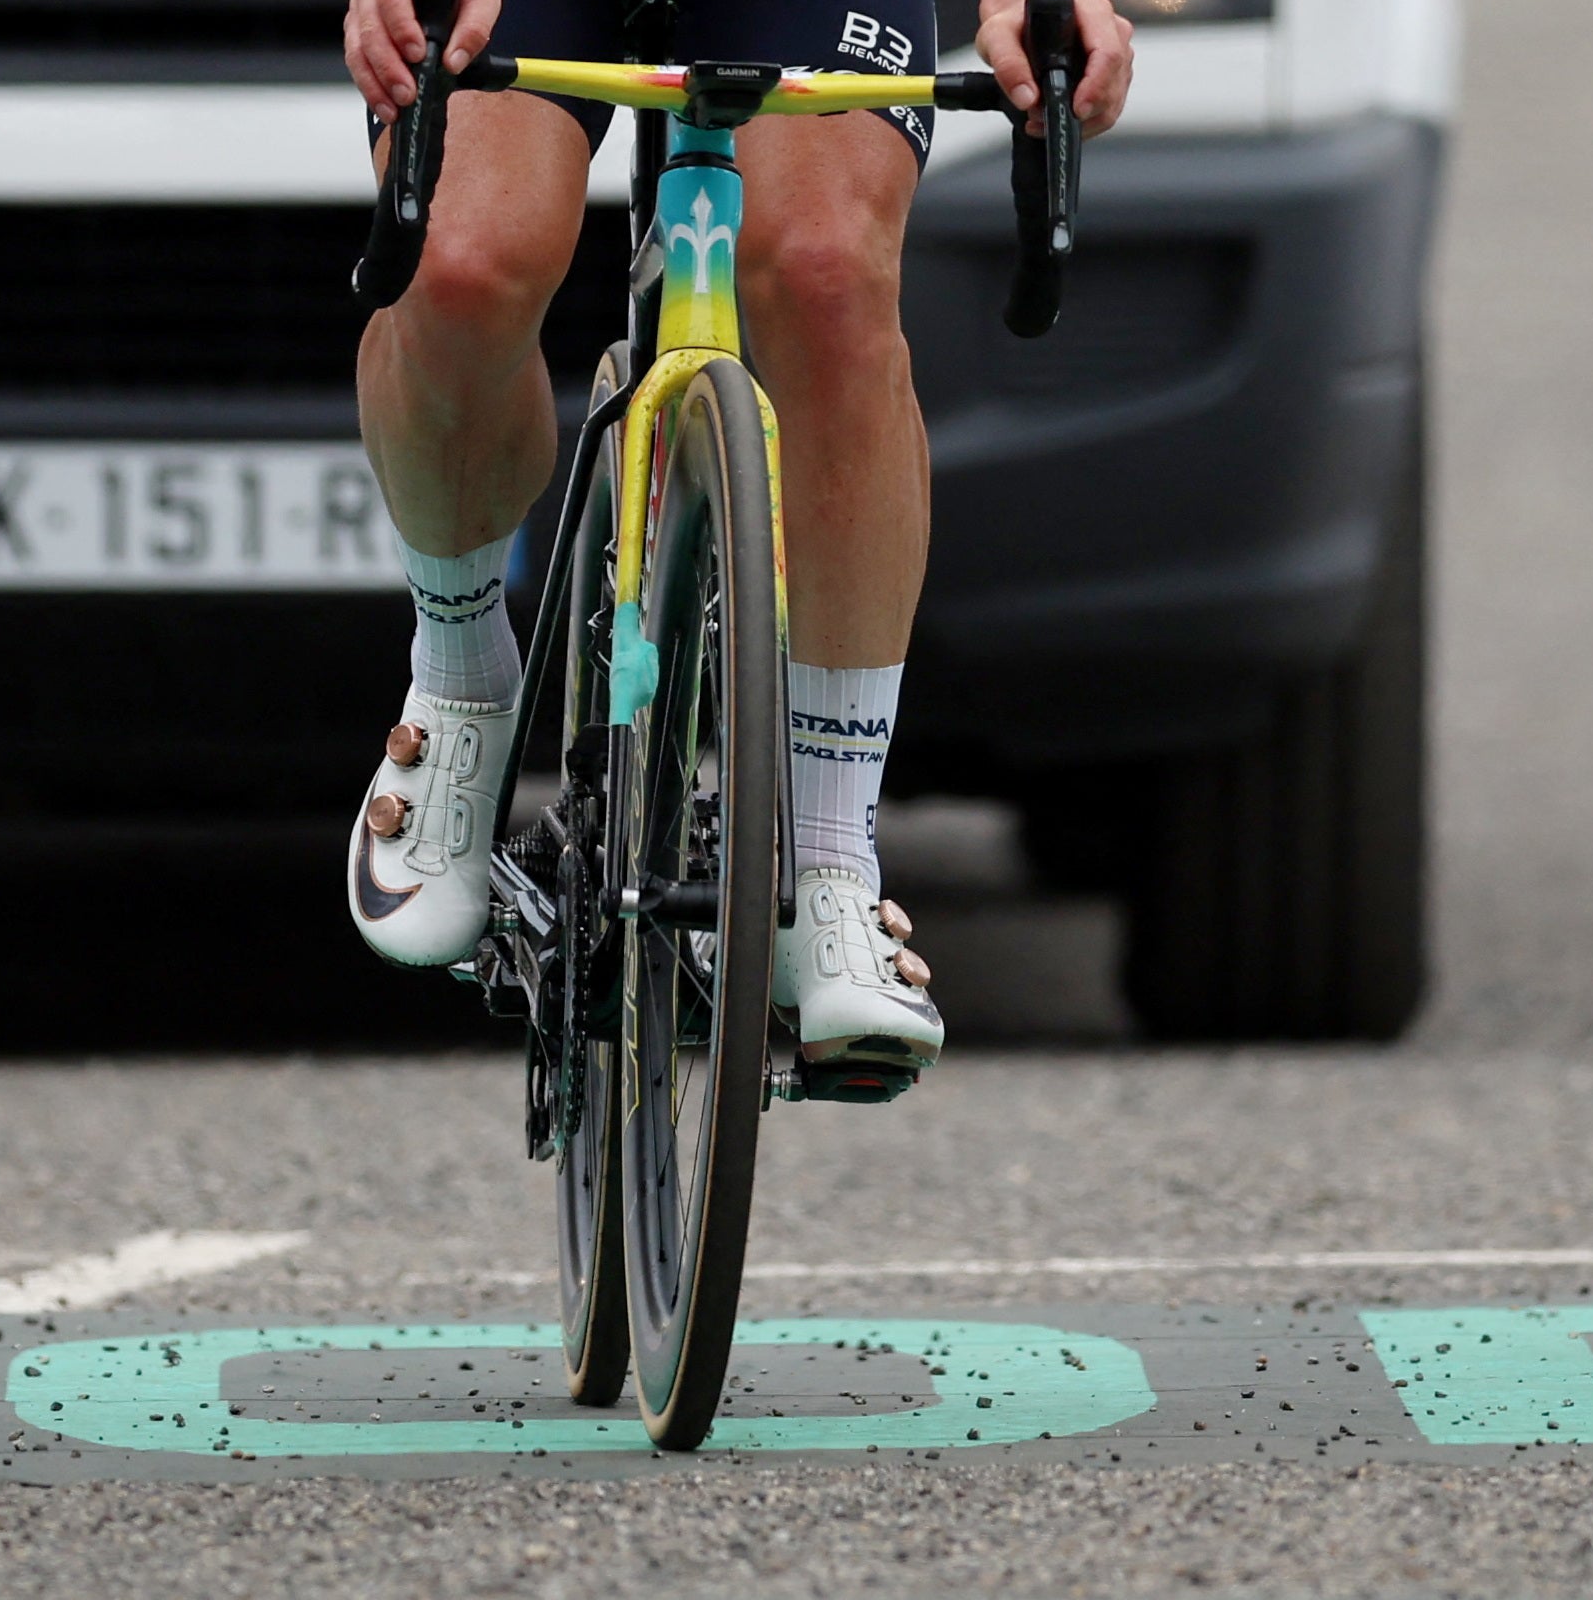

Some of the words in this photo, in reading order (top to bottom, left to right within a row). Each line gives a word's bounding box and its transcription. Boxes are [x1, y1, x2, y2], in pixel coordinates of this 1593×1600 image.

[841, 10, 913, 69] B3
[716, 67, 761, 78] GARMIN
[836, 41, 907, 77] BIEMME
[1058, 103, 1067, 216] DURA-ACE
[407, 572, 502, 606] STANA
[791, 710, 890, 741] STANA
[793, 742, 885, 763] ZAQSTAN
